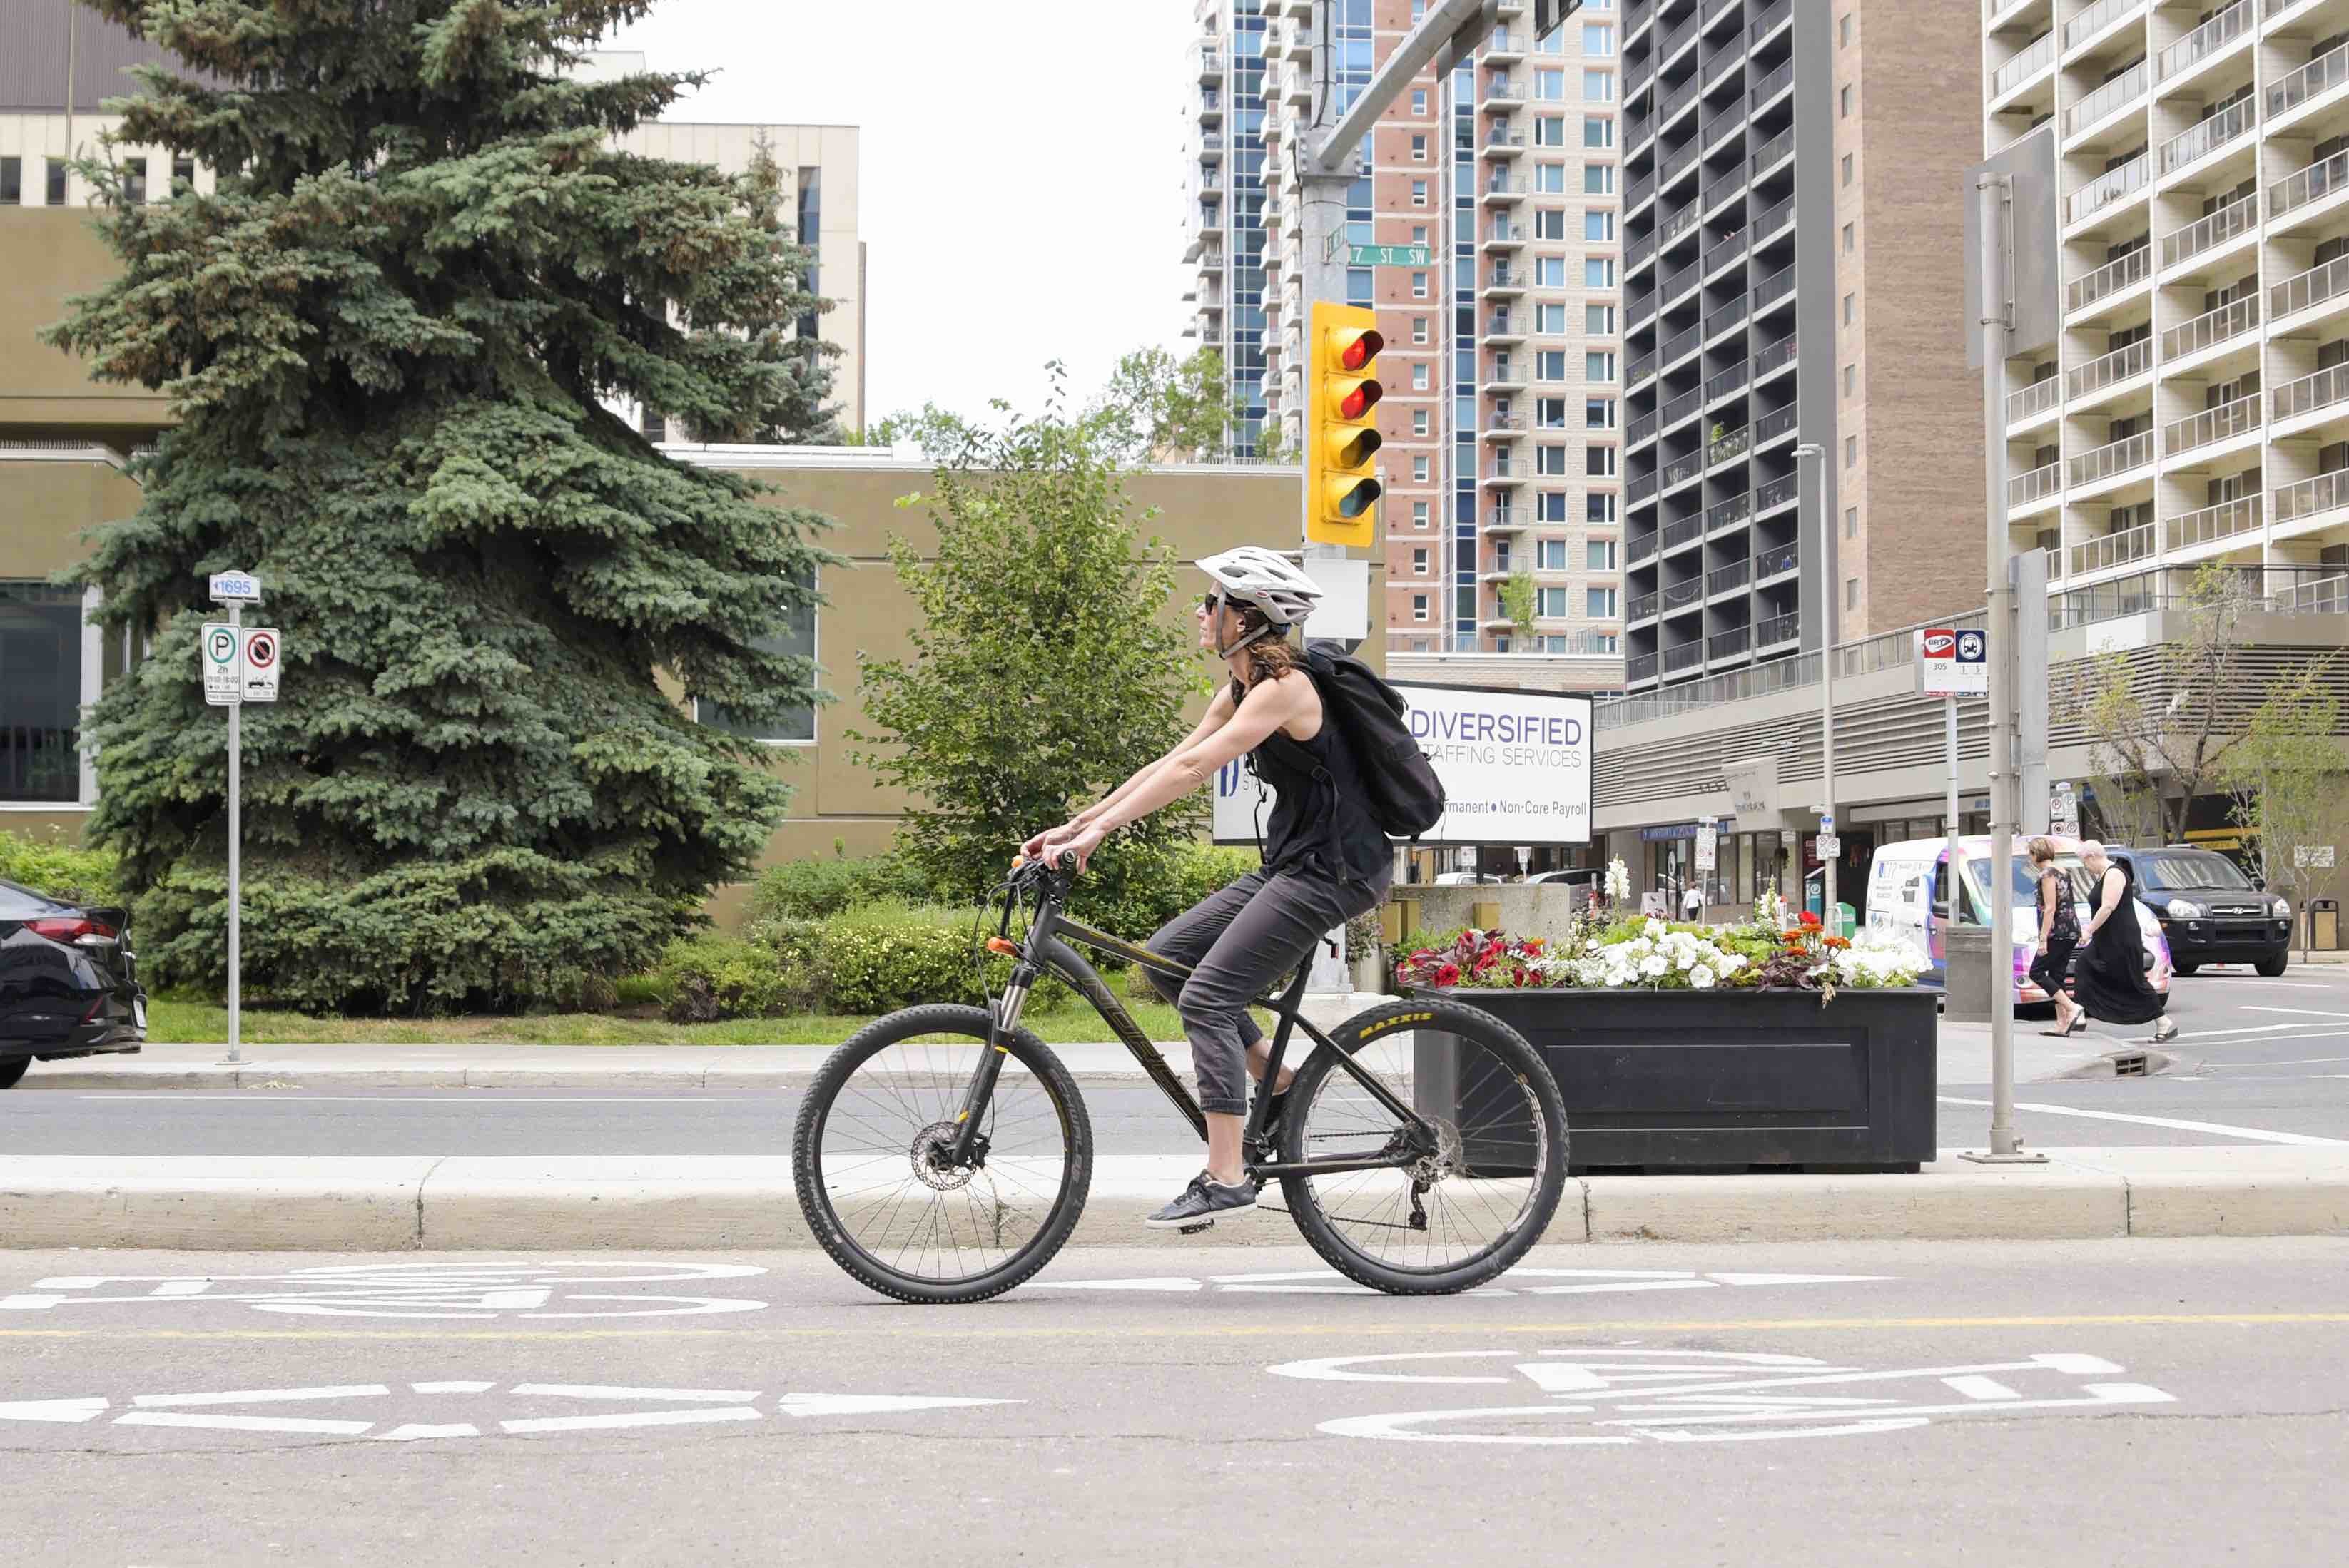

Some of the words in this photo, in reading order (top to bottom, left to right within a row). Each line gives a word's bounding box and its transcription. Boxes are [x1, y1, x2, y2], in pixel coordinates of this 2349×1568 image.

[1352, 247, 1364, 263] 7
[1380, 248, 1394, 263] ST
[1408, 248, 1426, 265] SW
[220, 580, 251, 594] 1695
[215, 635, 229, 656] P
[1411, 709, 1581, 745] DIVERSIFIED
[1421, 743, 1495, 765] TAFFING
[1502, 747, 1581, 768] SERVICES
[1444, 800, 1488, 814] rmanent
[1499, 798, 1549, 815] Non-Core
[1552, 800, 1586, 819] Payroll
[1359, 1012, 1434, 1039] MAXXIS
